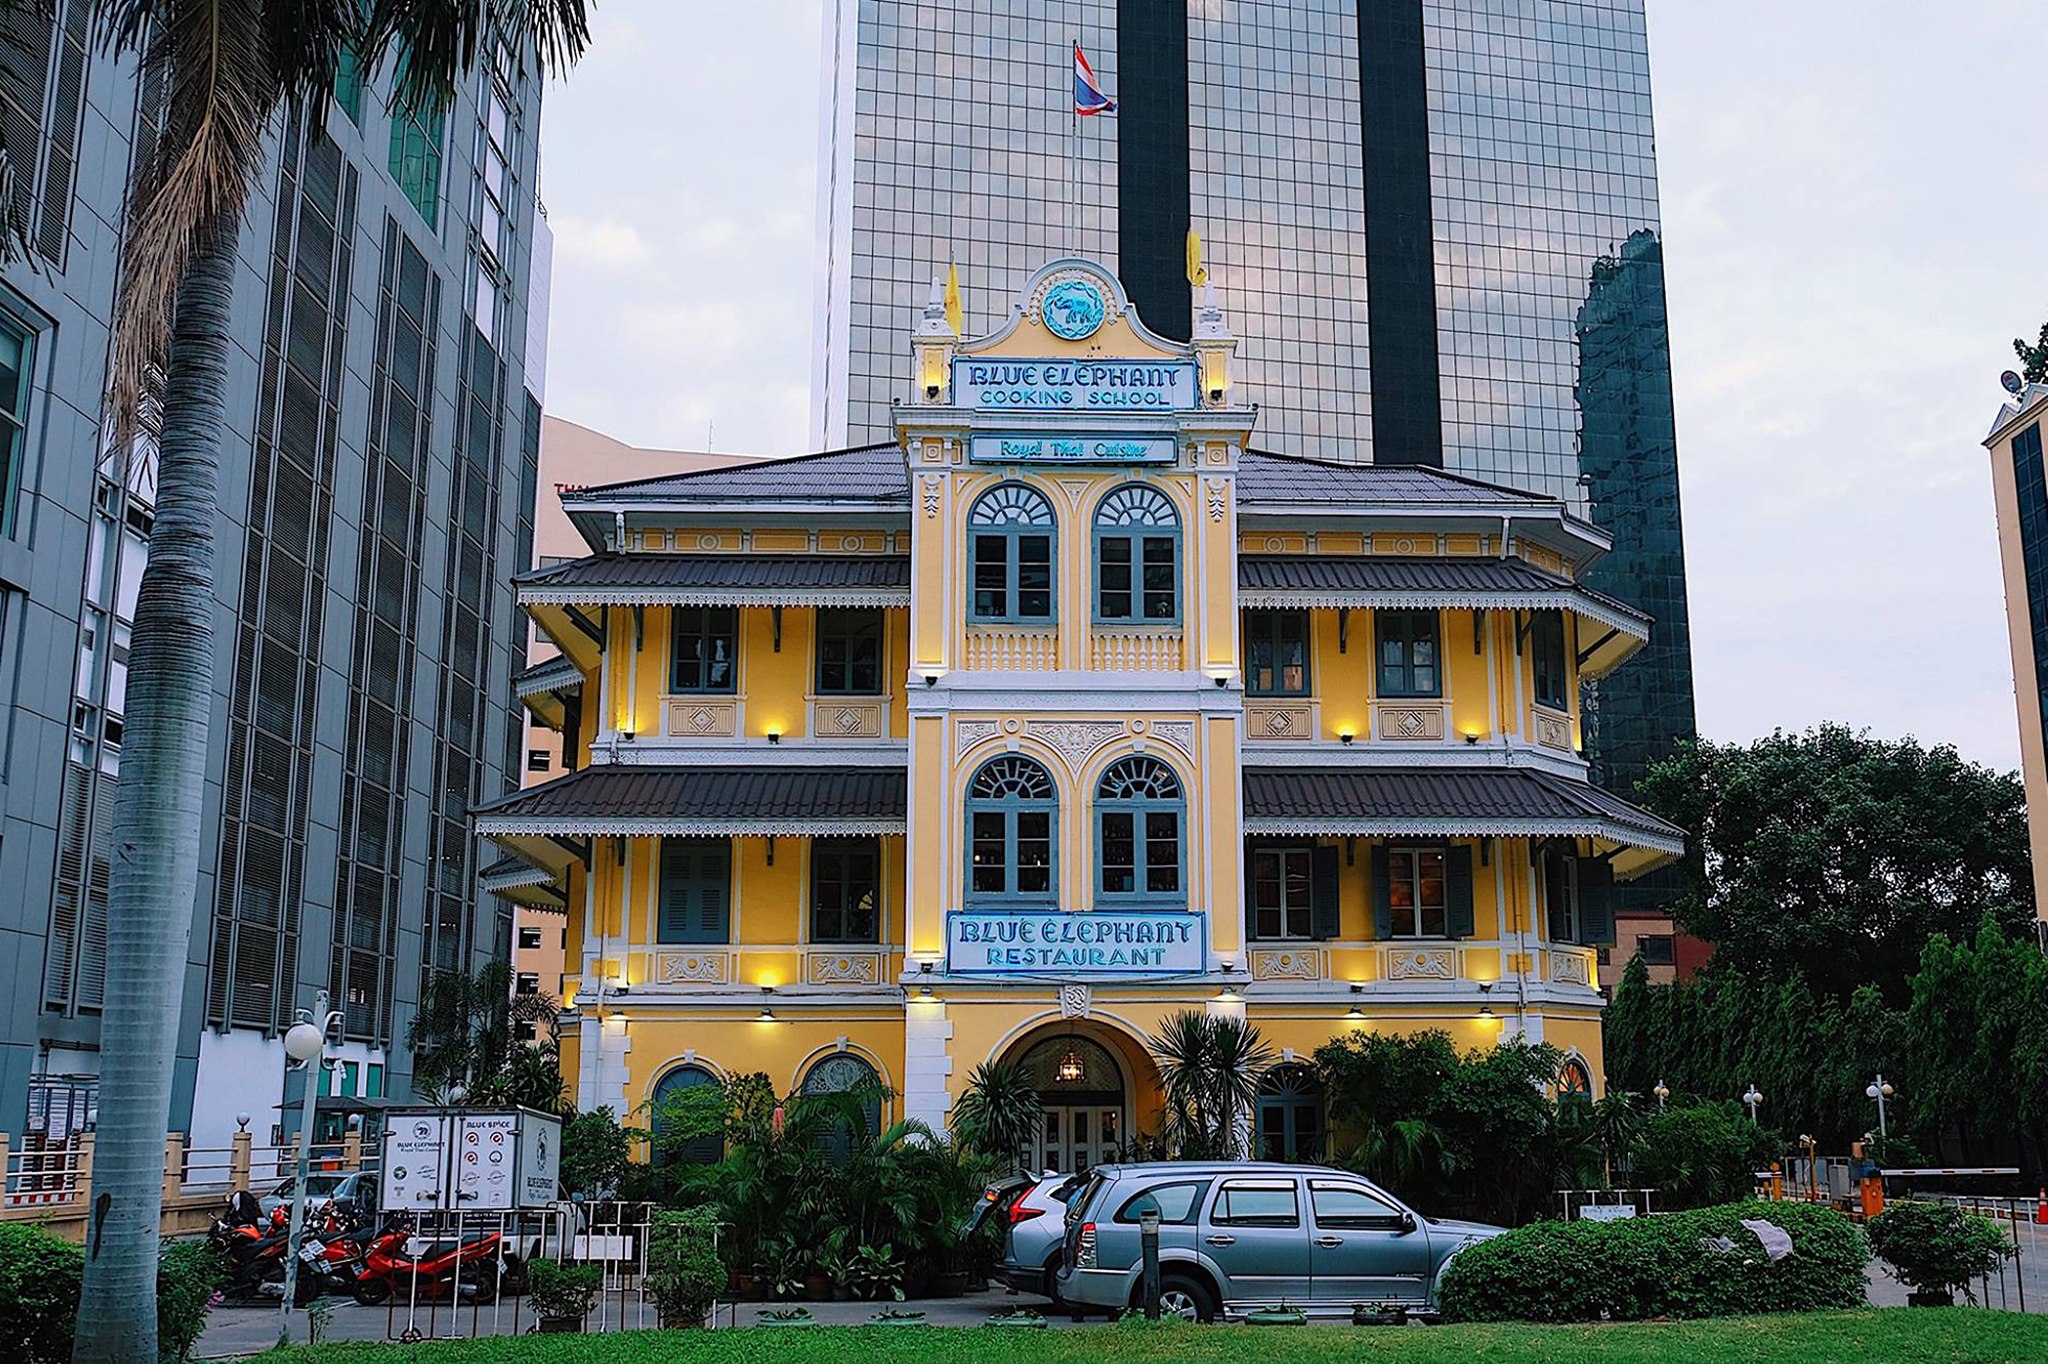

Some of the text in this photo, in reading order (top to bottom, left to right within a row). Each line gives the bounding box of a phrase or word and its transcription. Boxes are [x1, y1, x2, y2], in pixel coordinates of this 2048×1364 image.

[968, 366, 1181, 387] BLUE ELEPHANT
[980, 390, 1170, 406] COOKING SCHOOL
[1000, 440, 1147, 459] Royal Thai Cuisine
[959, 920, 1193, 944] BLUE ELEPHANT
[986, 947, 1167, 966] RESTAURANT
